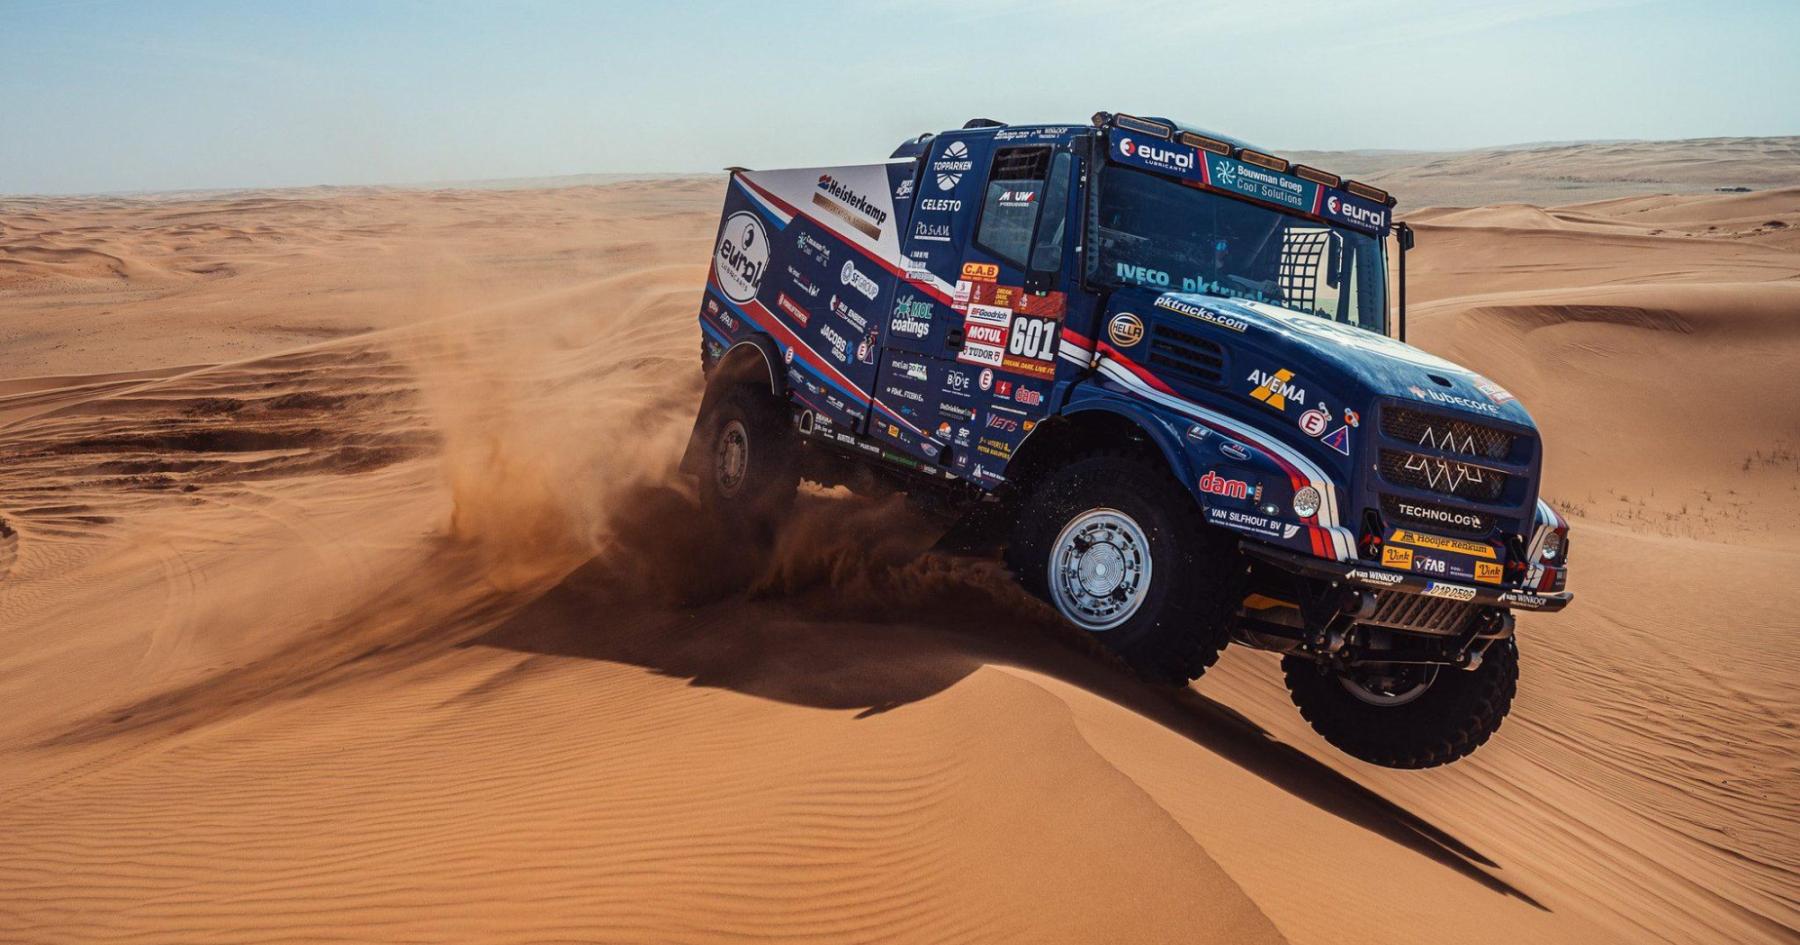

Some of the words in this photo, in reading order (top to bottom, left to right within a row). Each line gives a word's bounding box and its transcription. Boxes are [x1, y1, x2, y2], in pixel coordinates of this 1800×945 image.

[933, 161, 973, 171] TOPPARKEN
[1137, 144, 1194, 168] eurol
[1145, 159, 1186, 173] LUBRICANTS
[1237, 166, 1277, 184] Bouwman
[1279, 177, 1302, 193] Groep
[828, 179, 887, 225] Heisterkamp
[1236, 179, 1257, 193] Cool
[1261, 185, 1302, 206] Solutions
[921, 198, 961, 212] CELESTO
[1341, 203, 1384, 226] eurol
[720, 239, 762, 289] eurol
[965, 265, 995, 276] C.A.B
[1116, 262, 1170, 286] IVECO
[911, 301, 932, 318] MOL
[971, 308, 1007, 319] BFGoodrich
[1154, 296, 1248, 331] pktrucks.com
[892, 317, 929, 337] coatings
[968, 325, 1001, 342] MOTUL
[1112, 322, 1142, 337] HELLA
[821, 324, 847, 352] JACOBS
[1009, 316, 1056, 361] 601
[969, 347, 993, 359] TUDOR
[1015, 385, 1040, 406] dam
[1247, 369, 1306, 405] AVEMA
[1427, 389, 1499, 413] lubecore
[1306, 416, 1320, 431] E
[1199, 471, 1247, 499] dam
[1211, 508, 1227, 519] VAN
[1229, 512, 1268, 527] SILFHOUT
[1270, 520, 1282, 530] BV
[1417, 534, 1450, 547] Hooijer
[1451, 540, 1487, 553] Renkum
[1387, 548, 1410, 561] Vink
[1424, 559, 1446, 572] FAB
[1479, 564, 1500, 576] Vink
[1356, 571, 1368, 579] van
[1369, 571, 1403, 584] WINKOOP
